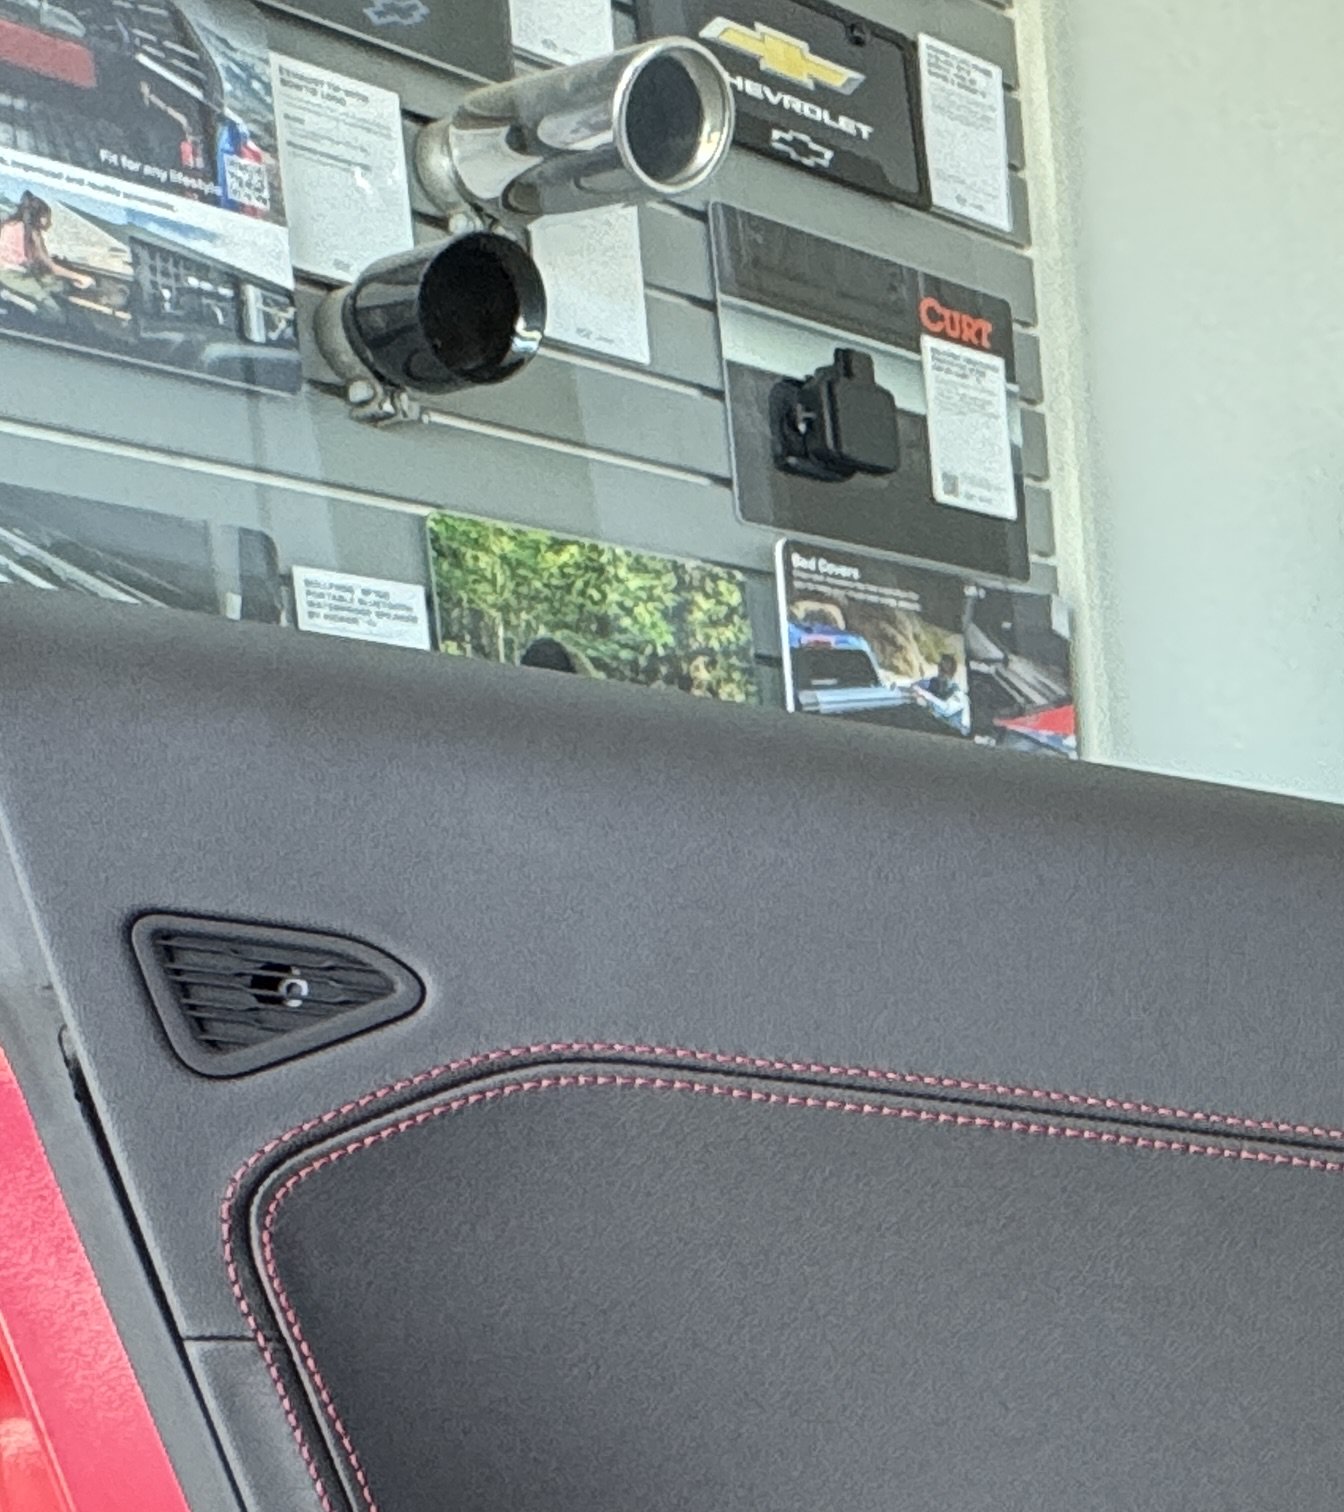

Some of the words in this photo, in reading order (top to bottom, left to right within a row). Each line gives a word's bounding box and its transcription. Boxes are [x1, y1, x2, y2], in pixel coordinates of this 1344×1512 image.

[730, 75, 874, 141] HEVROLET
[100, 148, 119, 167] Fit
[120, 154, 141, 172] for
[143, 164, 167, 183] any
[791, 552, 816, 571] Bed
[818, 557, 860, 581] Covers
